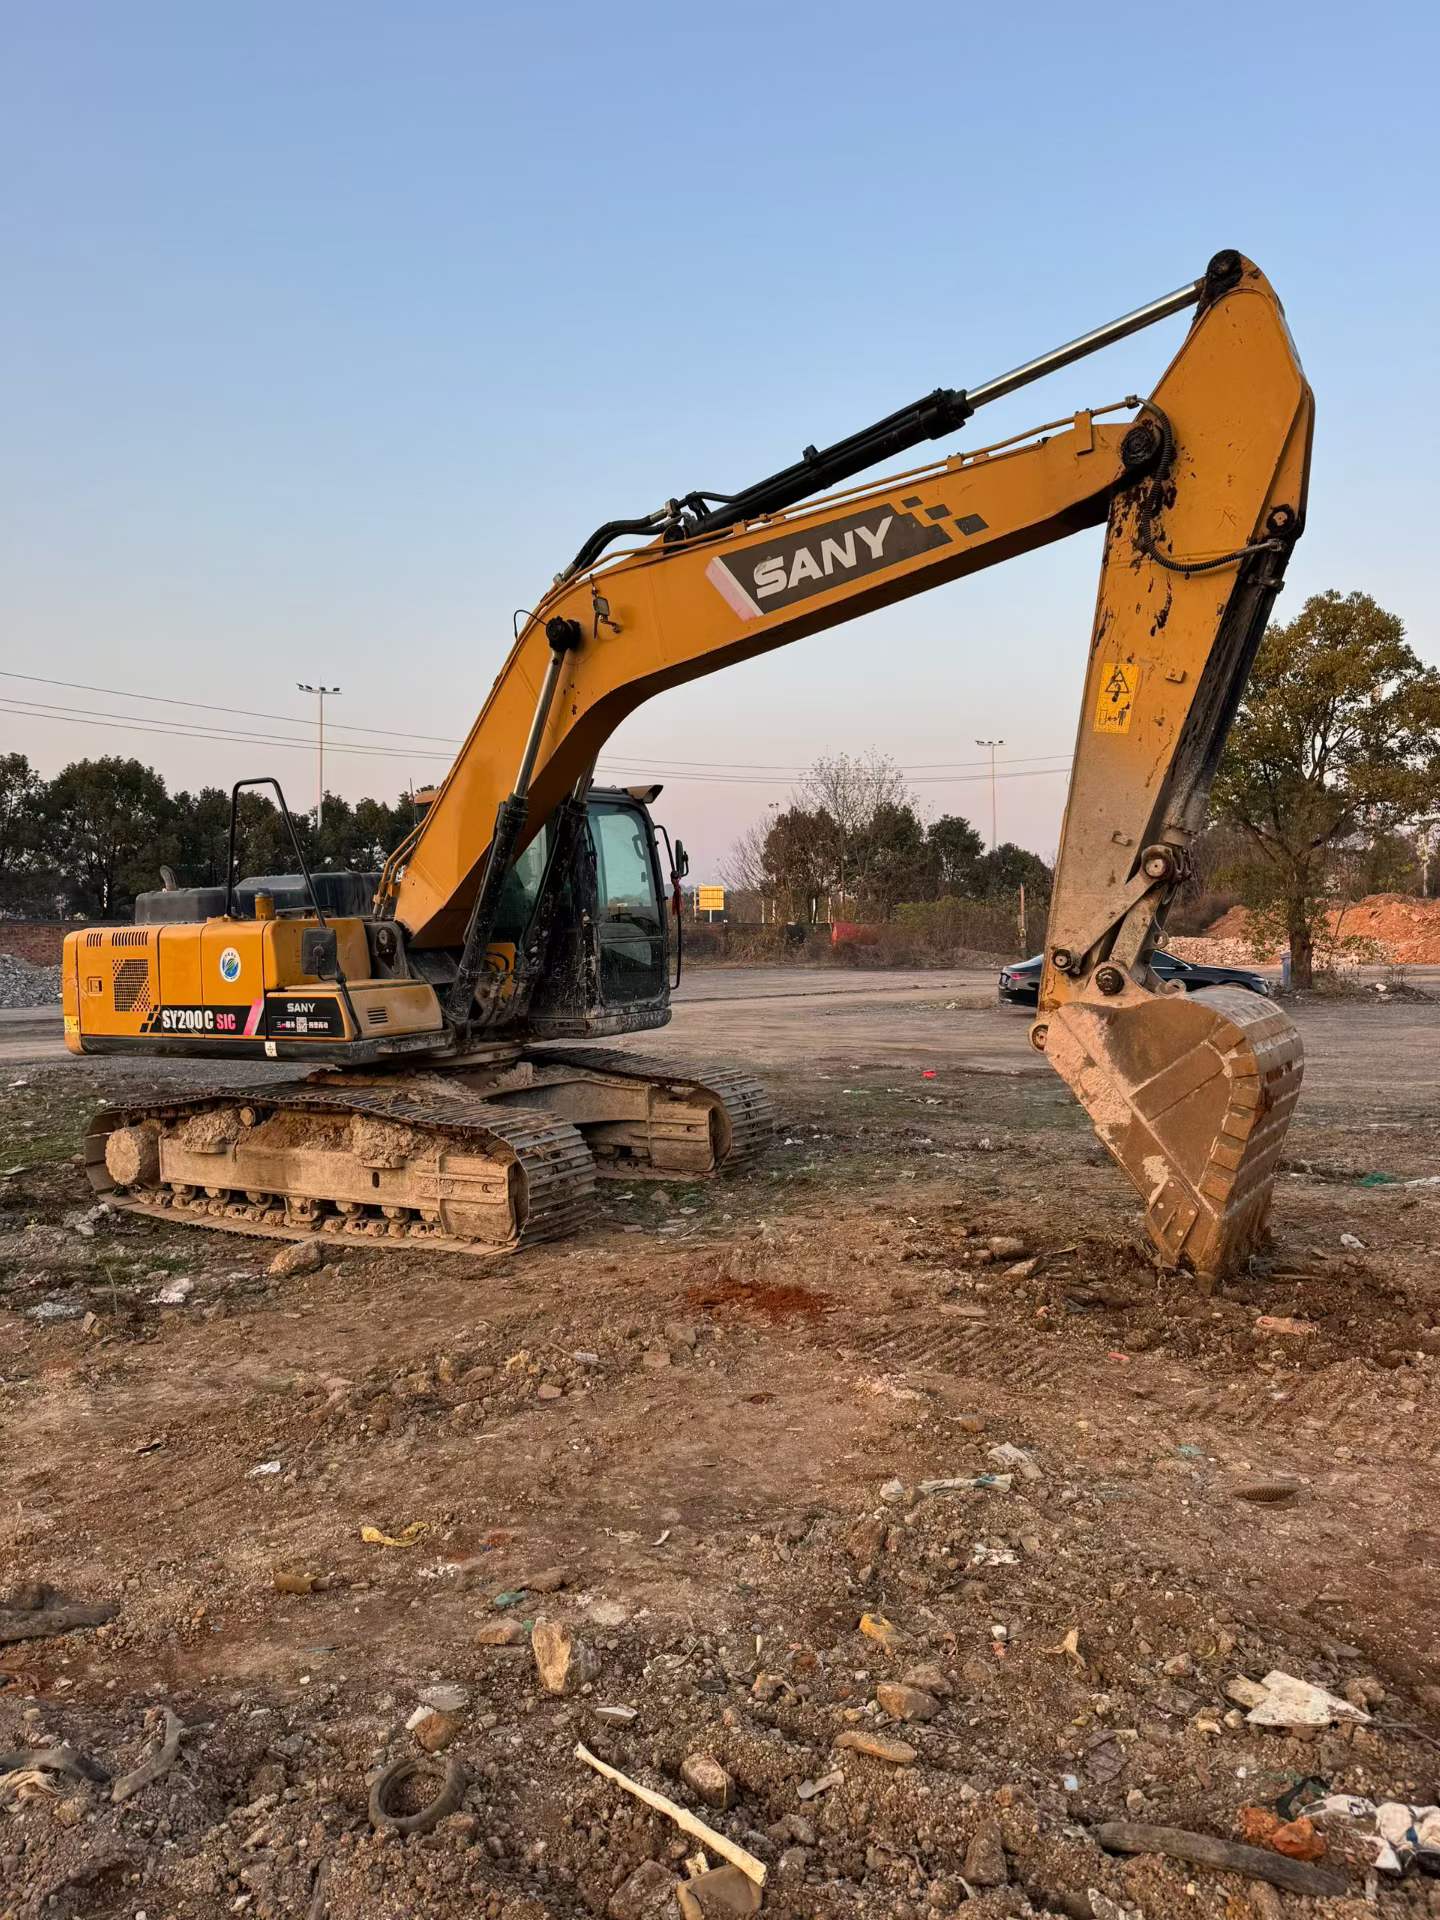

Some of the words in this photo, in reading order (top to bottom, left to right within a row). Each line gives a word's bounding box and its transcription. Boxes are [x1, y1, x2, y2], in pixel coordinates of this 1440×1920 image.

[753, 515, 894, 599] SANY
[287, 1003, 315, 1012] SANY
[216, 1014, 236, 1030] SIC
